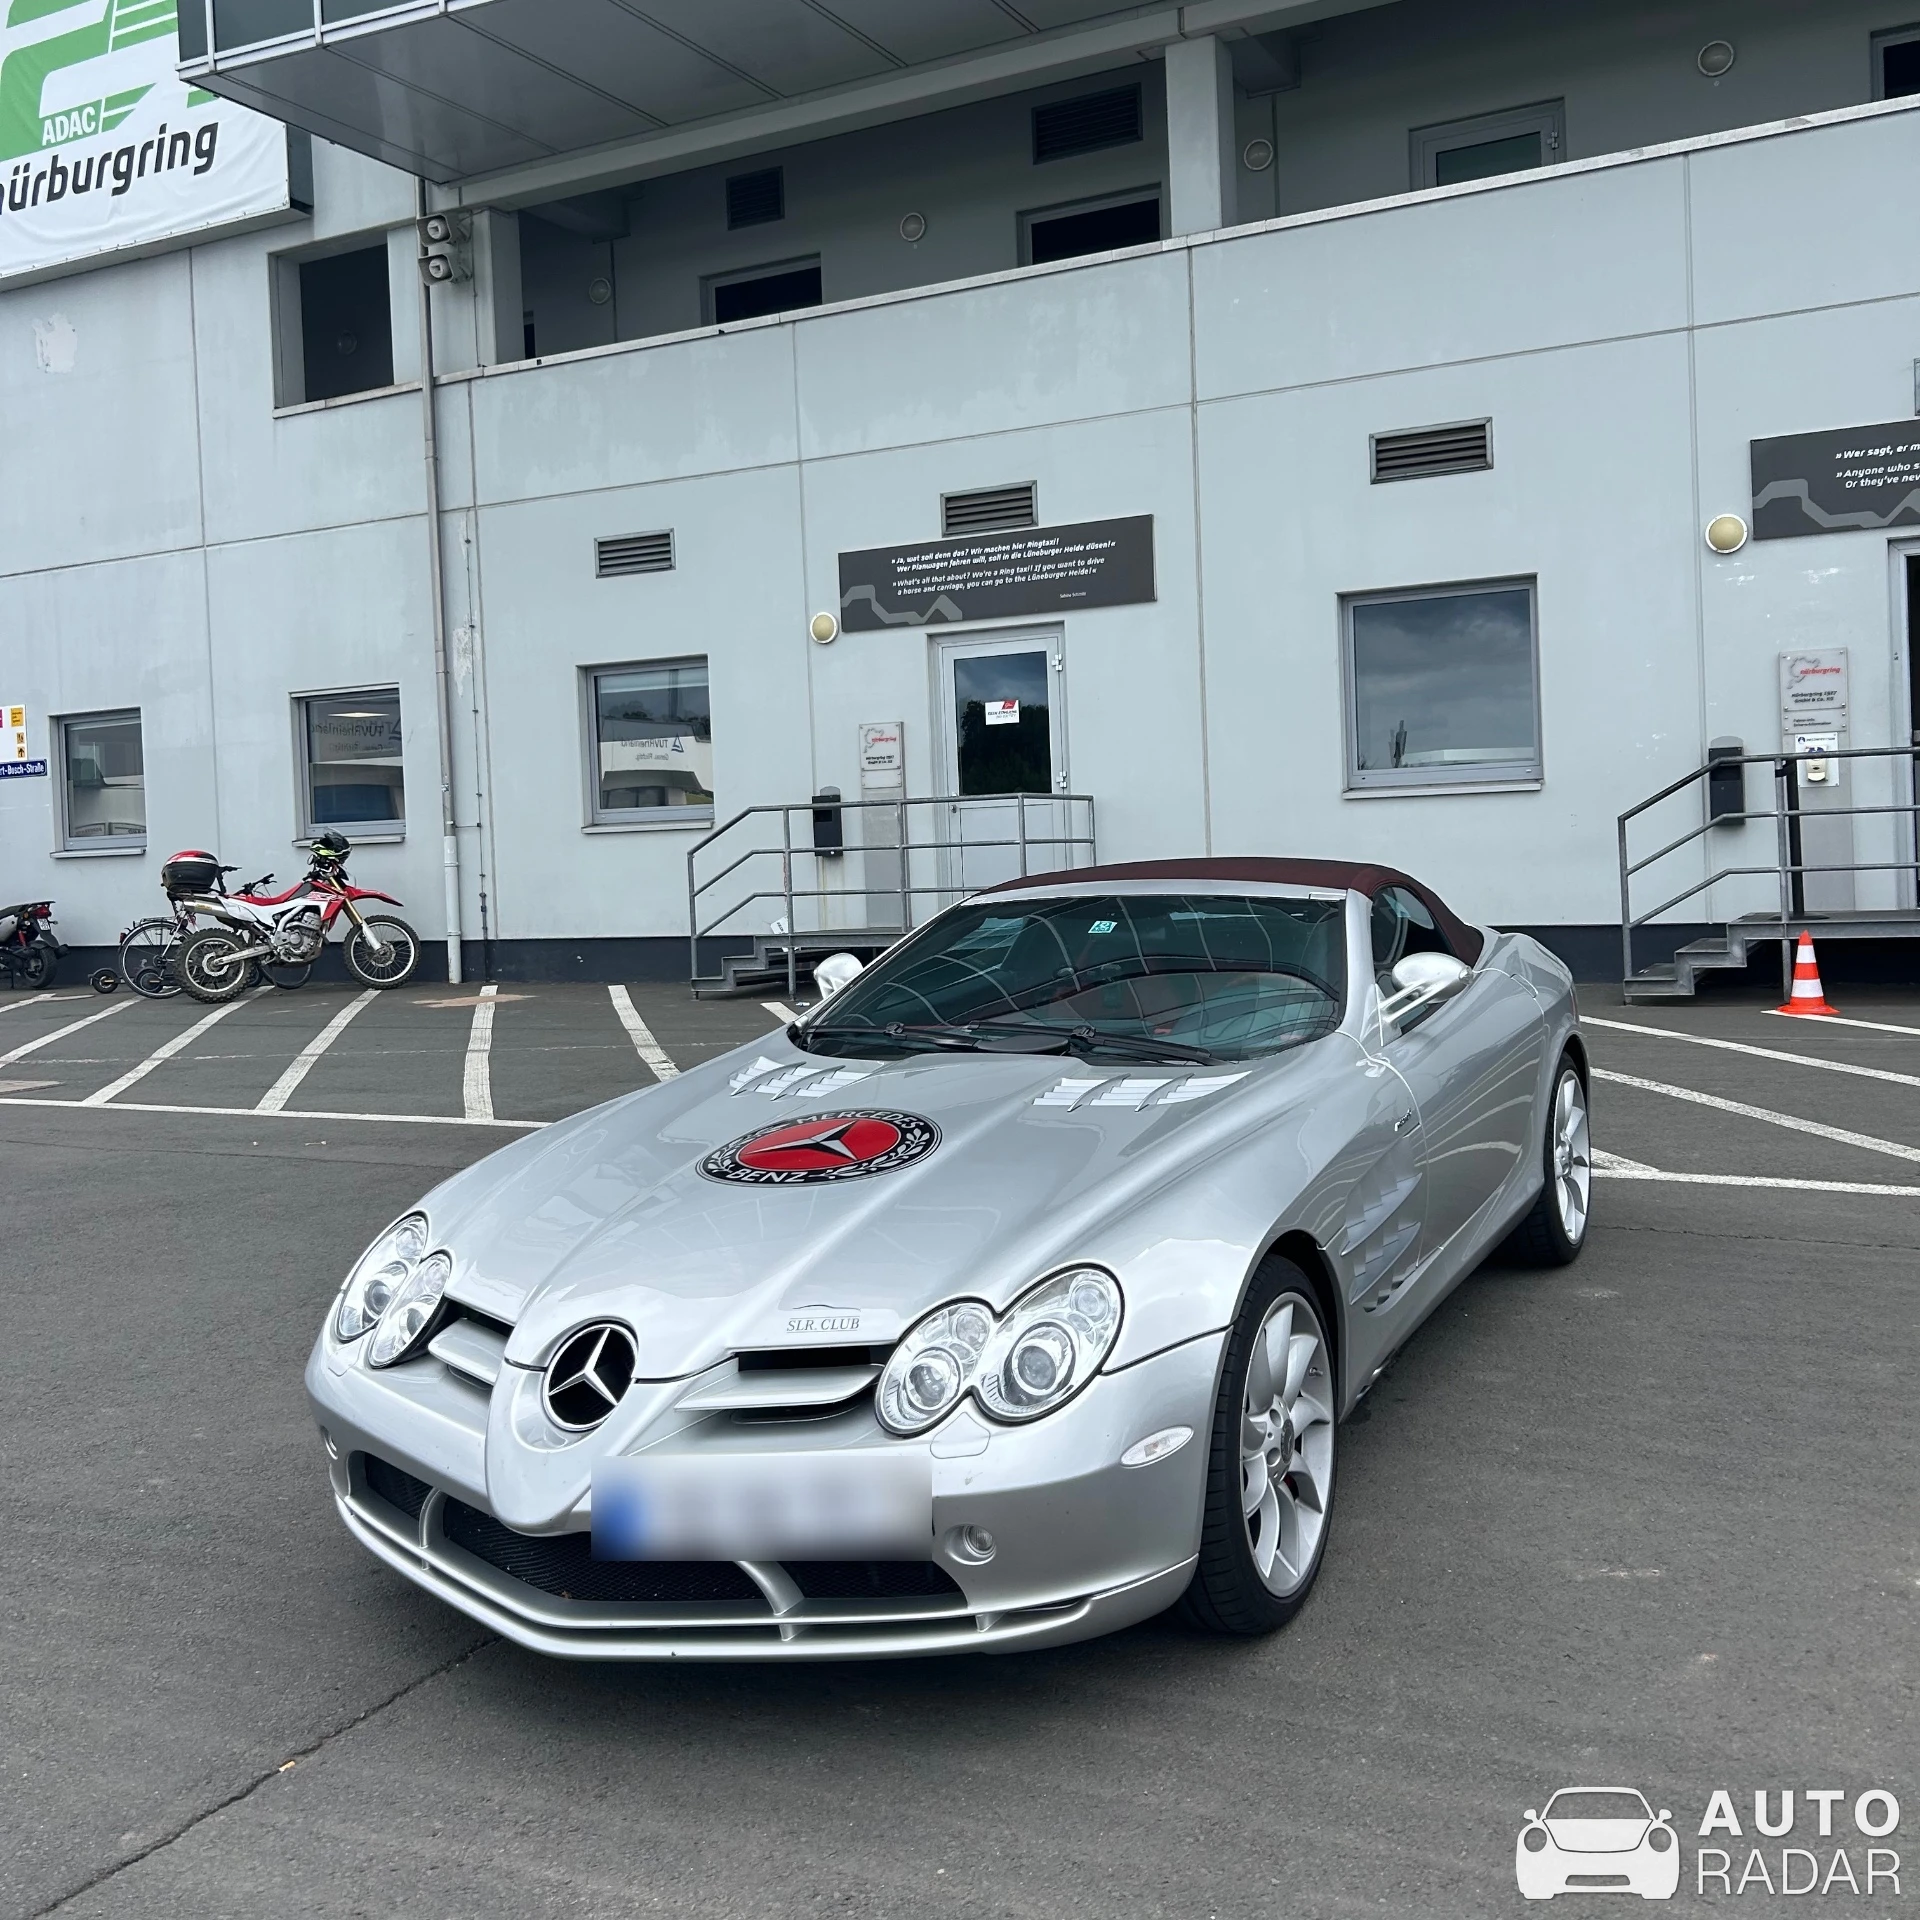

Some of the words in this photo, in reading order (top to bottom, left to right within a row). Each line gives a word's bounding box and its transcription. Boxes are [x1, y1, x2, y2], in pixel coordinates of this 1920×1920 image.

[42, 106, 96, 147] ADAC
[1867, 446, 1894, 456] sagt,
[1896, 444, 1908, 452] er
[1888, 463, 1911, 472] who
[1846, 480, 1858, 488] Or
[1860, 476, 1899, 486] they've
[912, 562, 948, 570] Planwagen
[949, 558, 971, 568] fahren
[988, 554, 1001, 562] soll
[1023, 548, 1062, 558] Lüneburger
[1064, 544, 1084, 553] Heide
[921, 553, 933, 561] soll
[952, 549, 969, 557] das?
[971, 547, 982, 555] Wir
[984, 545, 1010, 554] machen
[1027, 538, 1059, 548] Ringtaxi!
[947, 572, 970, 581] about?
[972, 570, 992, 578] We're
[1016, 565, 1032, 573] taxi!
[1034, 564, 1041, 572] If
[1042, 563, 1056, 571] you
[1058, 560, 1076, 568] want
[1087, 557, 1105, 565] drive
[937, 582, 965, 590] carriage,
[1028, 572, 1067, 581] Lüneburger
[796, 1110, 924, 1129] MERCEDES
[726, 1169, 808, 1182] BENZ
[786, 1320, 818, 1332] SLR.
[820, 1317, 860, 1330] CLUB
